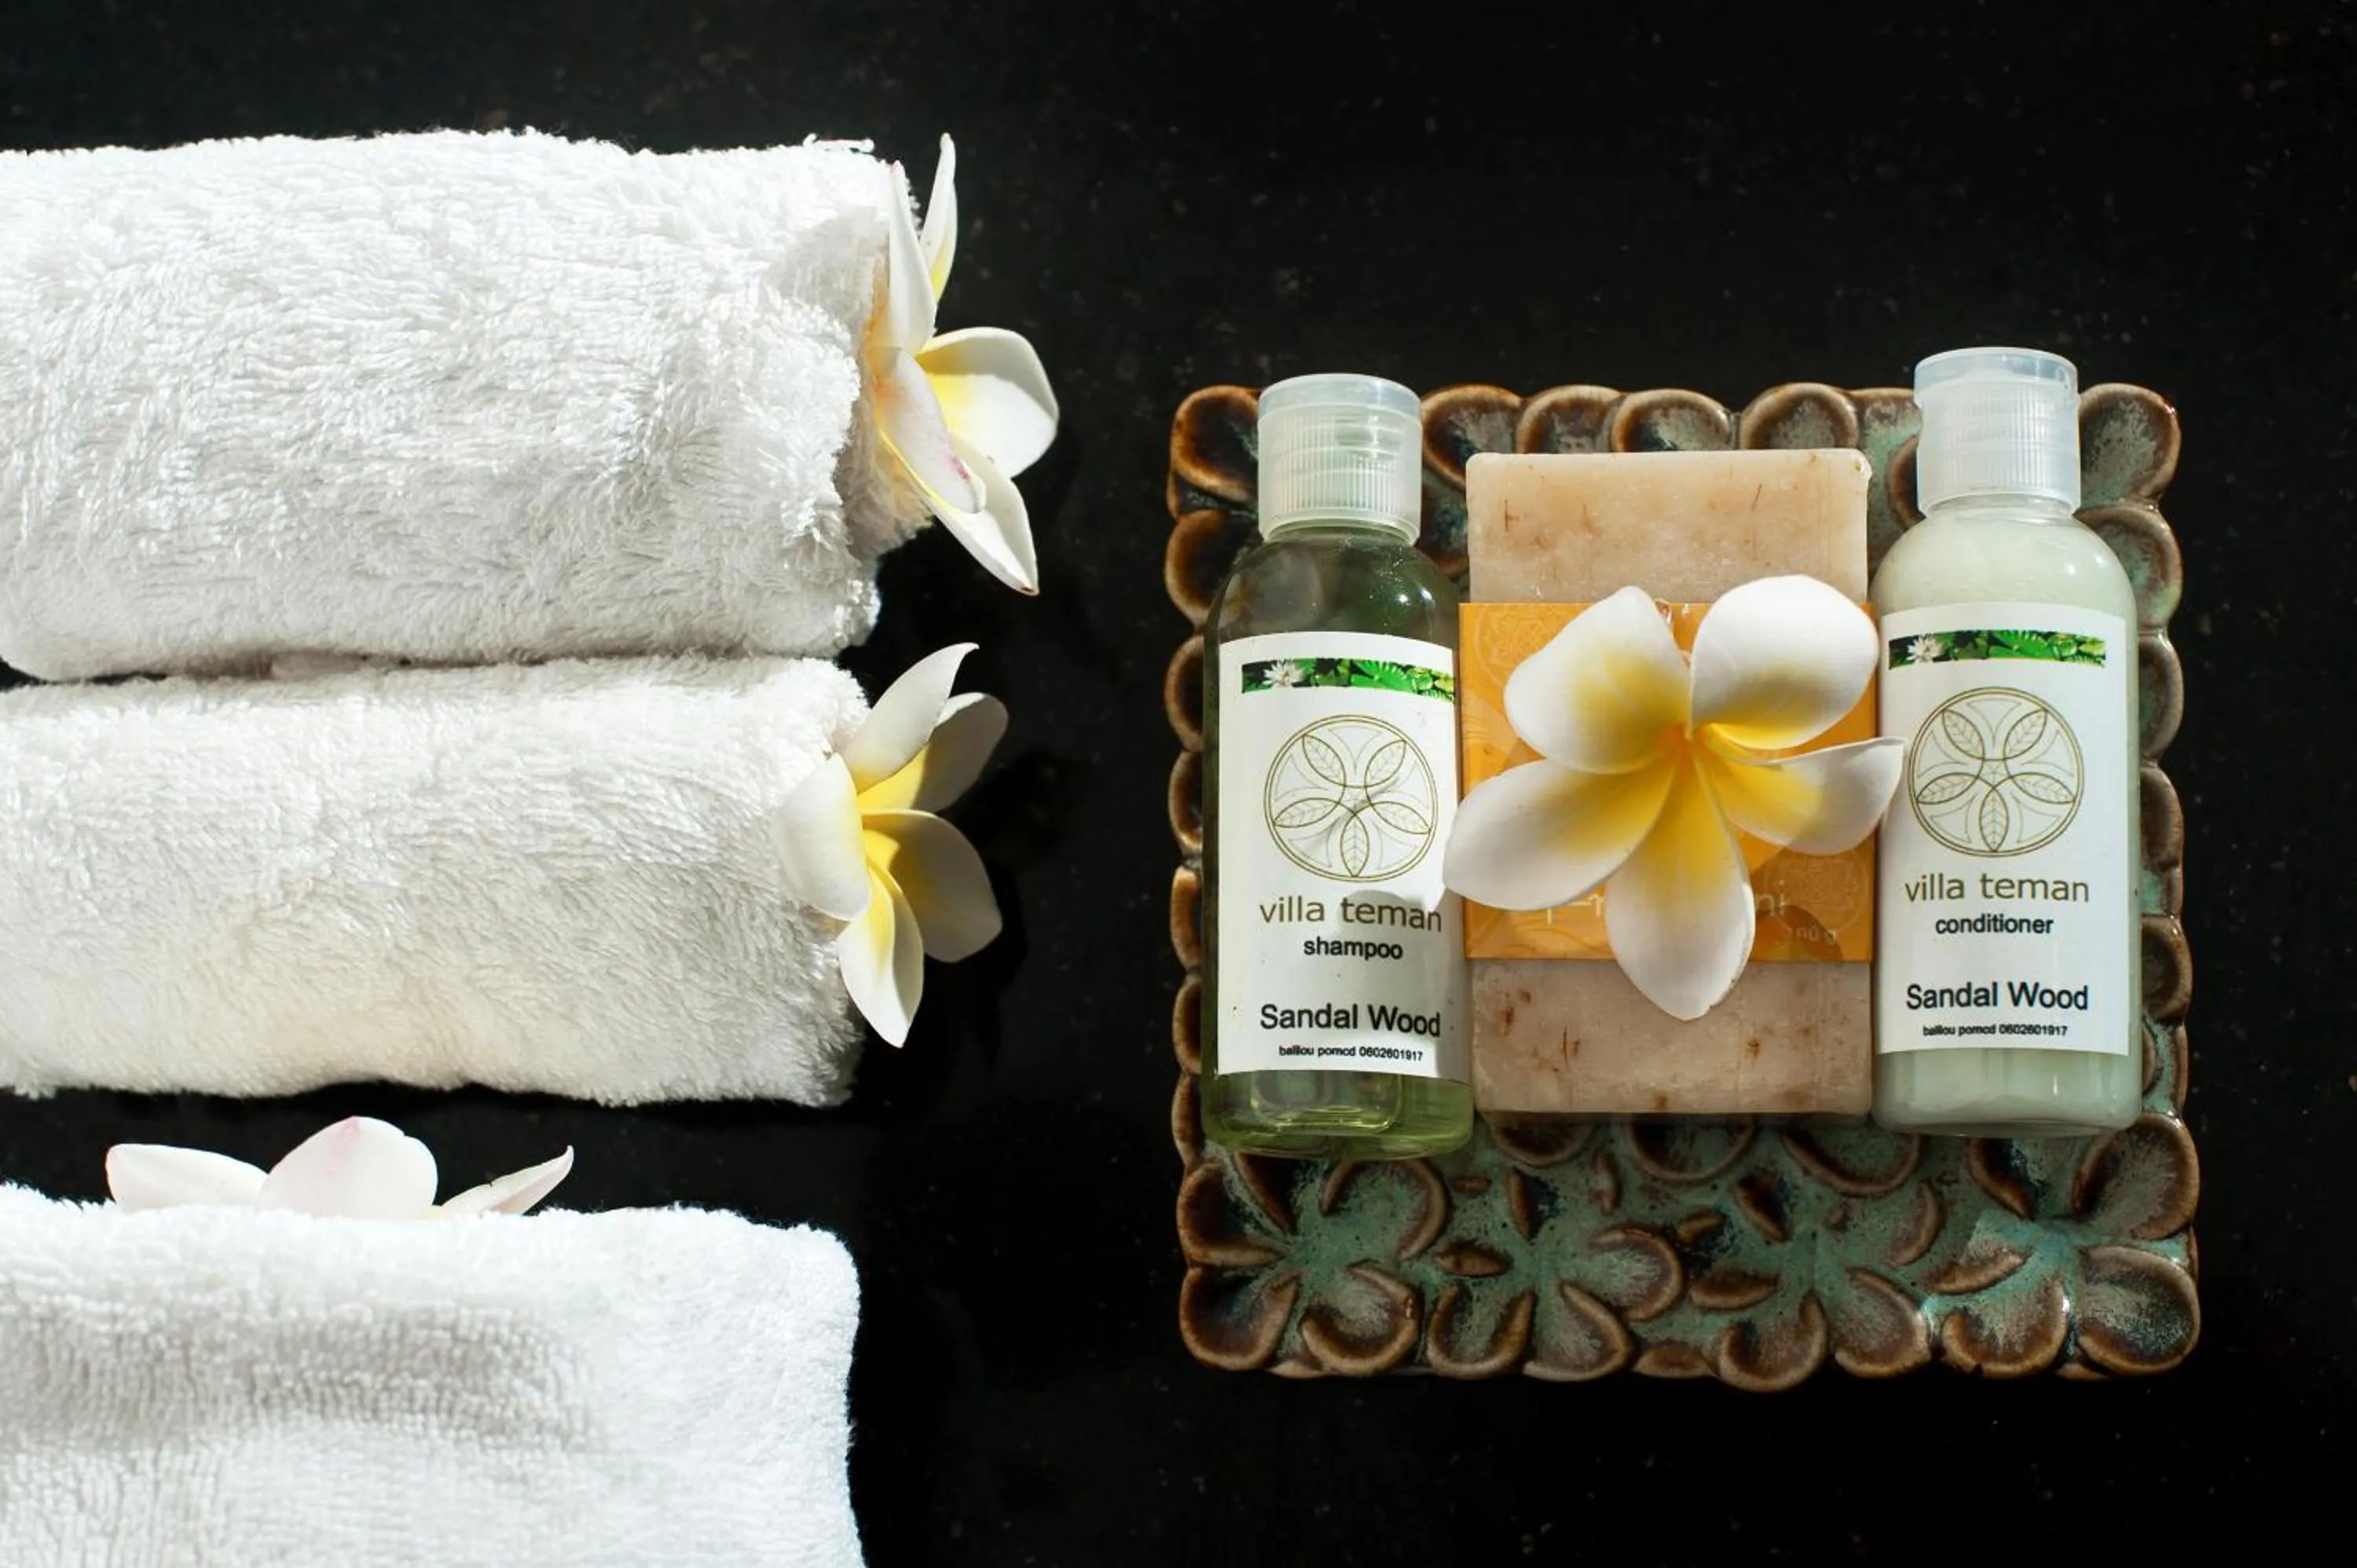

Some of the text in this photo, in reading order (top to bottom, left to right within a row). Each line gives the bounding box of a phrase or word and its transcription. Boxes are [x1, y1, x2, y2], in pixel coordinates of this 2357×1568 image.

[1904, 872, 2089, 903] villa teman
[1259, 895, 1442, 932] villa teman
[1935, 913, 2055, 935] conditioner
[1303, 936, 1403, 961] shampoo
[1906, 980, 2089, 1011] Sandal Wood
[1259, 1002, 1440, 1038] Sandal Wood
[1359, 1046, 1423, 1061] 0602601917
